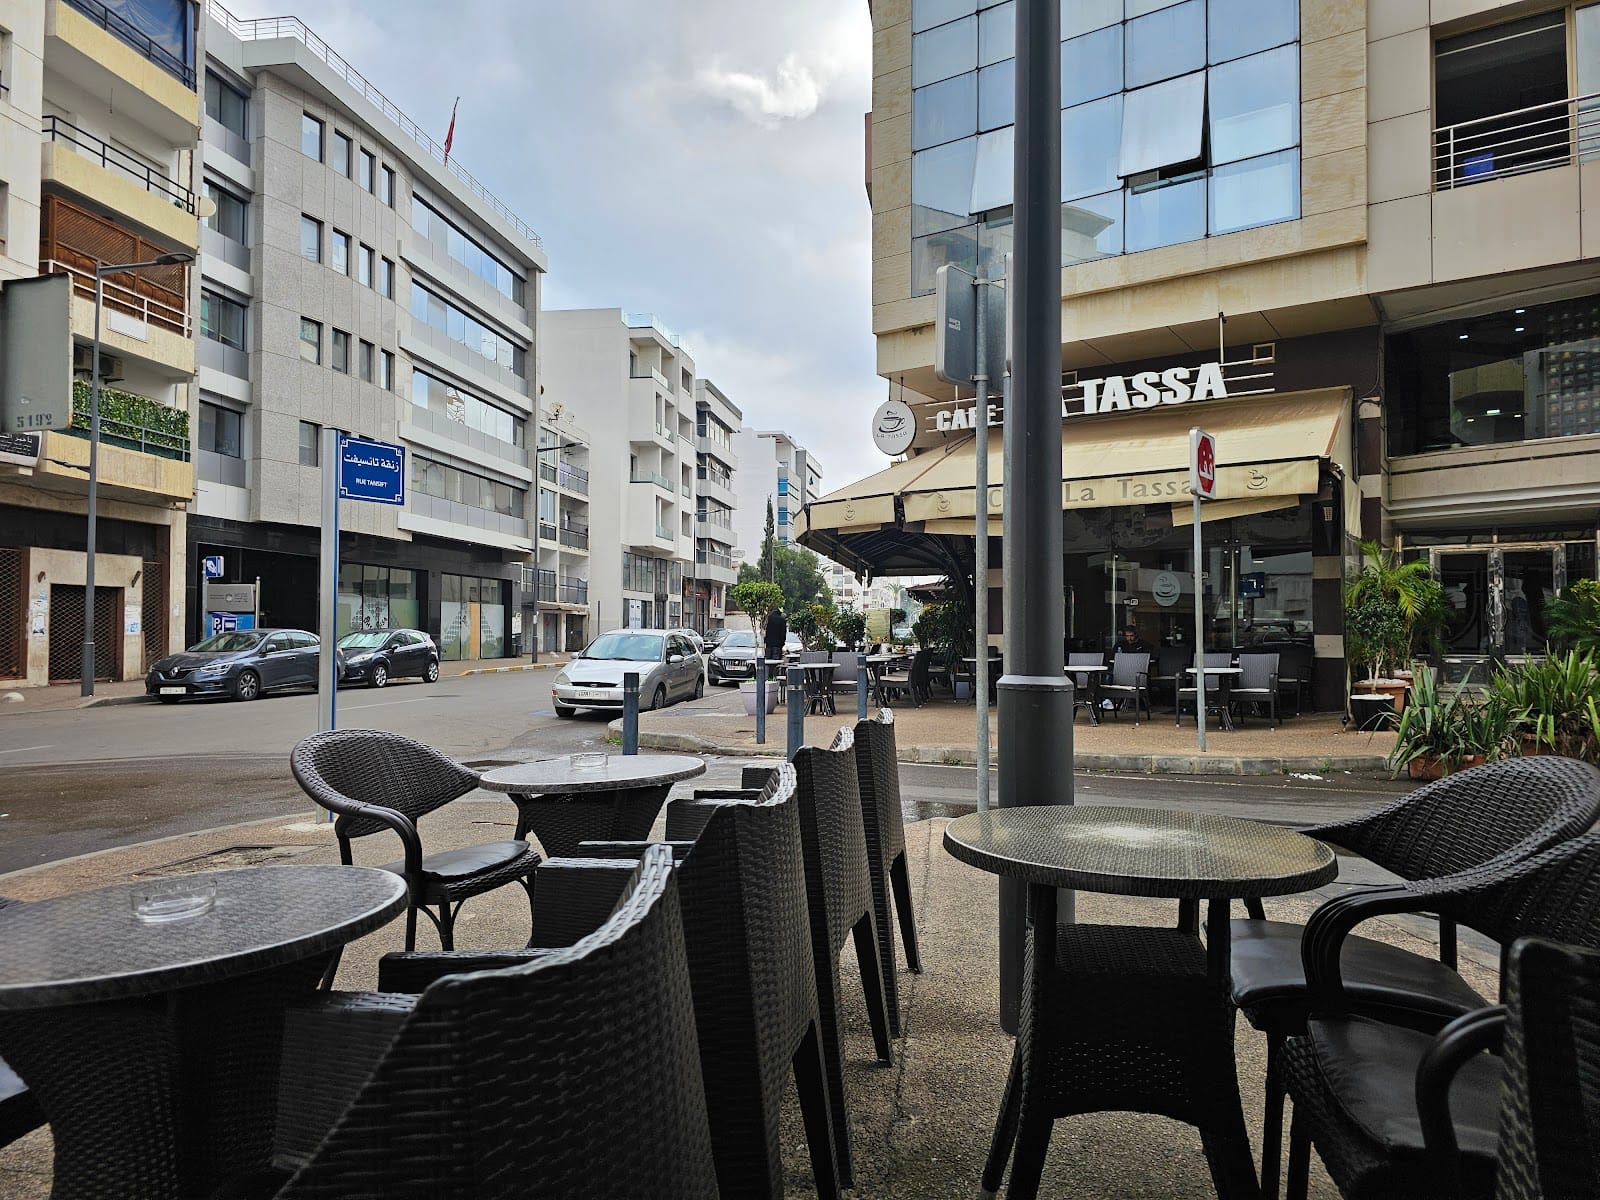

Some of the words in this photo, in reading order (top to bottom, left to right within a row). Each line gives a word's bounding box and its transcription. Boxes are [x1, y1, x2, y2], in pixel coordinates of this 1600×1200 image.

[1078, 362, 1228, 415] TASSA
[344, 455, 379, 466] تانسيفت
[381, 459, 399, 472] زنقة
[1199, 450, 1214, 481] قف
[1065, 483, 1096, 503] La
